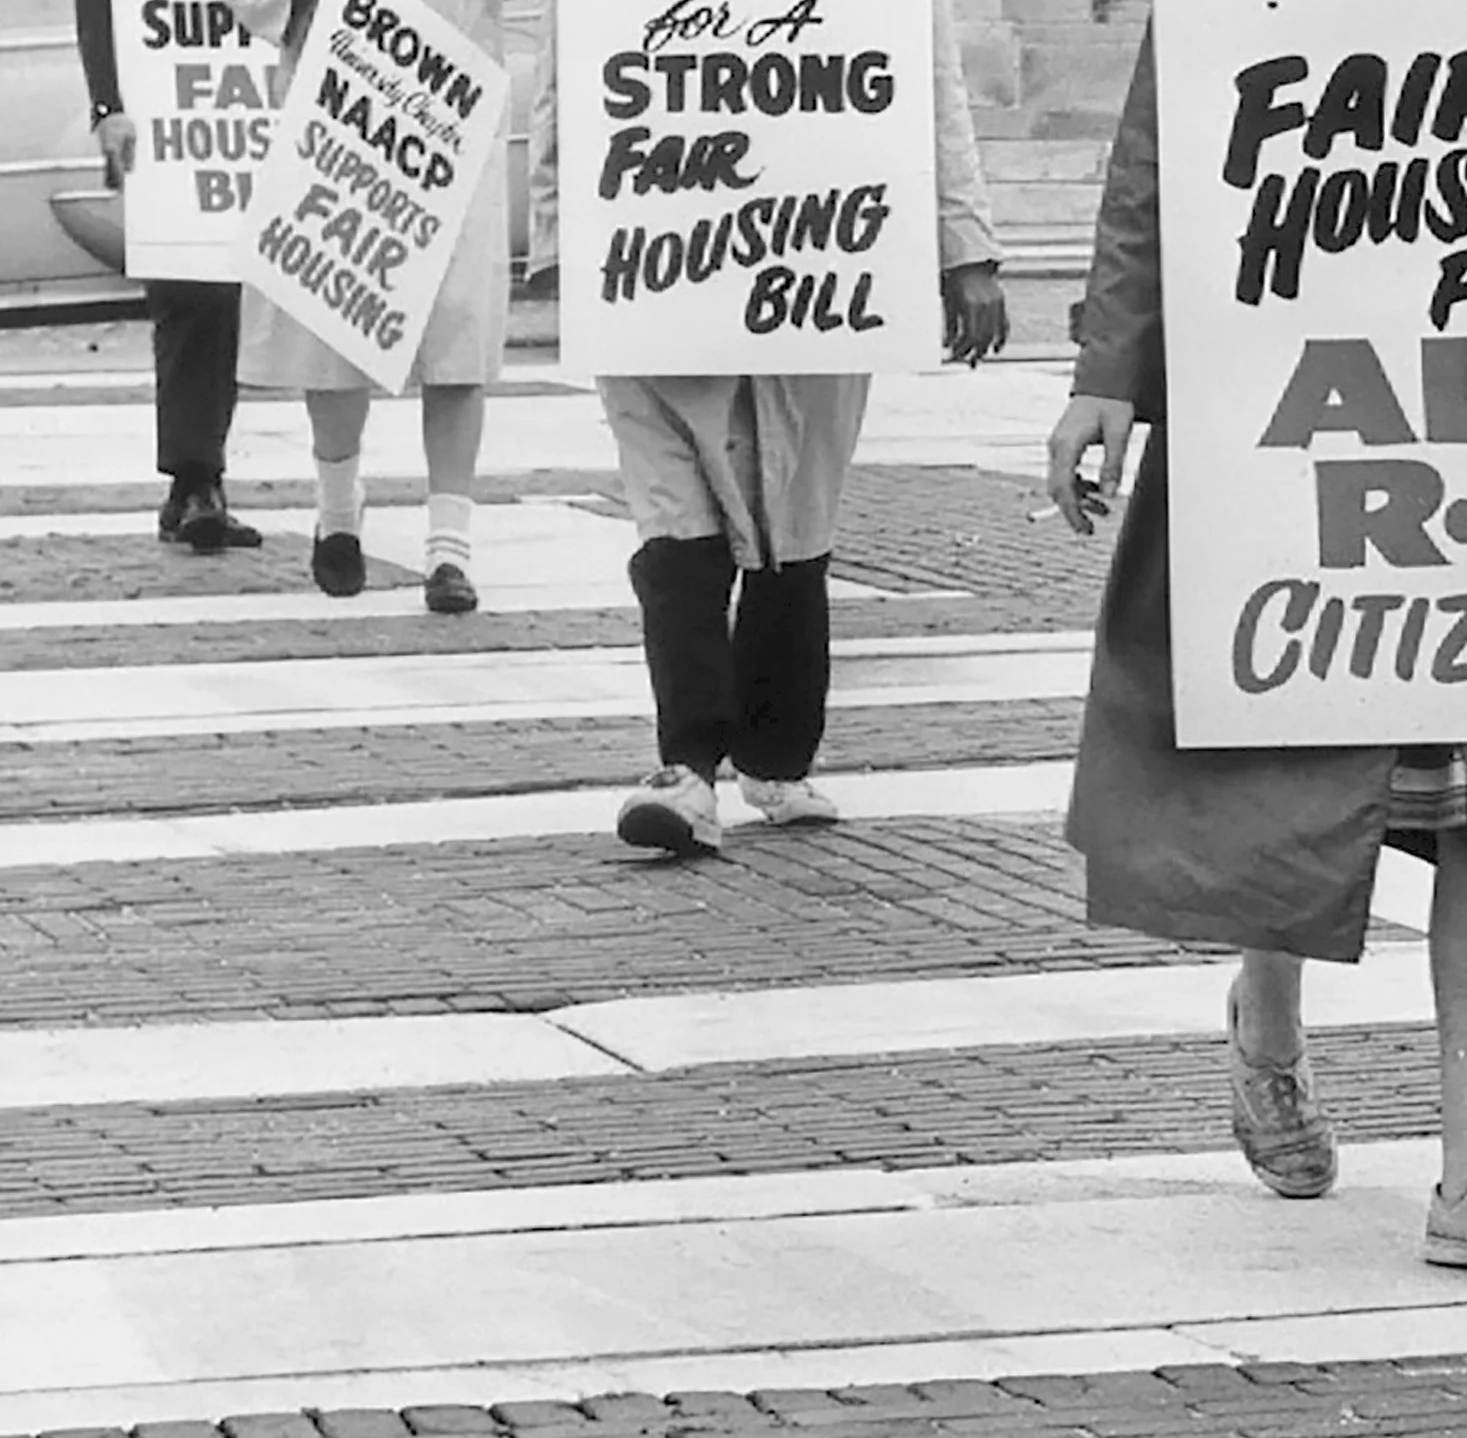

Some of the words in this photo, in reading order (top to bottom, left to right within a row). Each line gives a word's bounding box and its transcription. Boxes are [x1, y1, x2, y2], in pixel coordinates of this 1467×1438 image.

[175, 63, 282, 110] FAI
[602, 50, 895, 119] STRONG
[151, 116, 280, 162] HOUS
[315, 66, 455, 192] NAACP
[598, 125, 766, 201] FAIR
[194, 169, 254, 214] BI
[297, 120, 443, 250] SUPPORTS
[293, 183, 409, 292] FAIR
[599, 182, 892, 305] HOUSING
[258, 216, 406, 351] HOUSING
[743, 264, 885, 335] BILL
